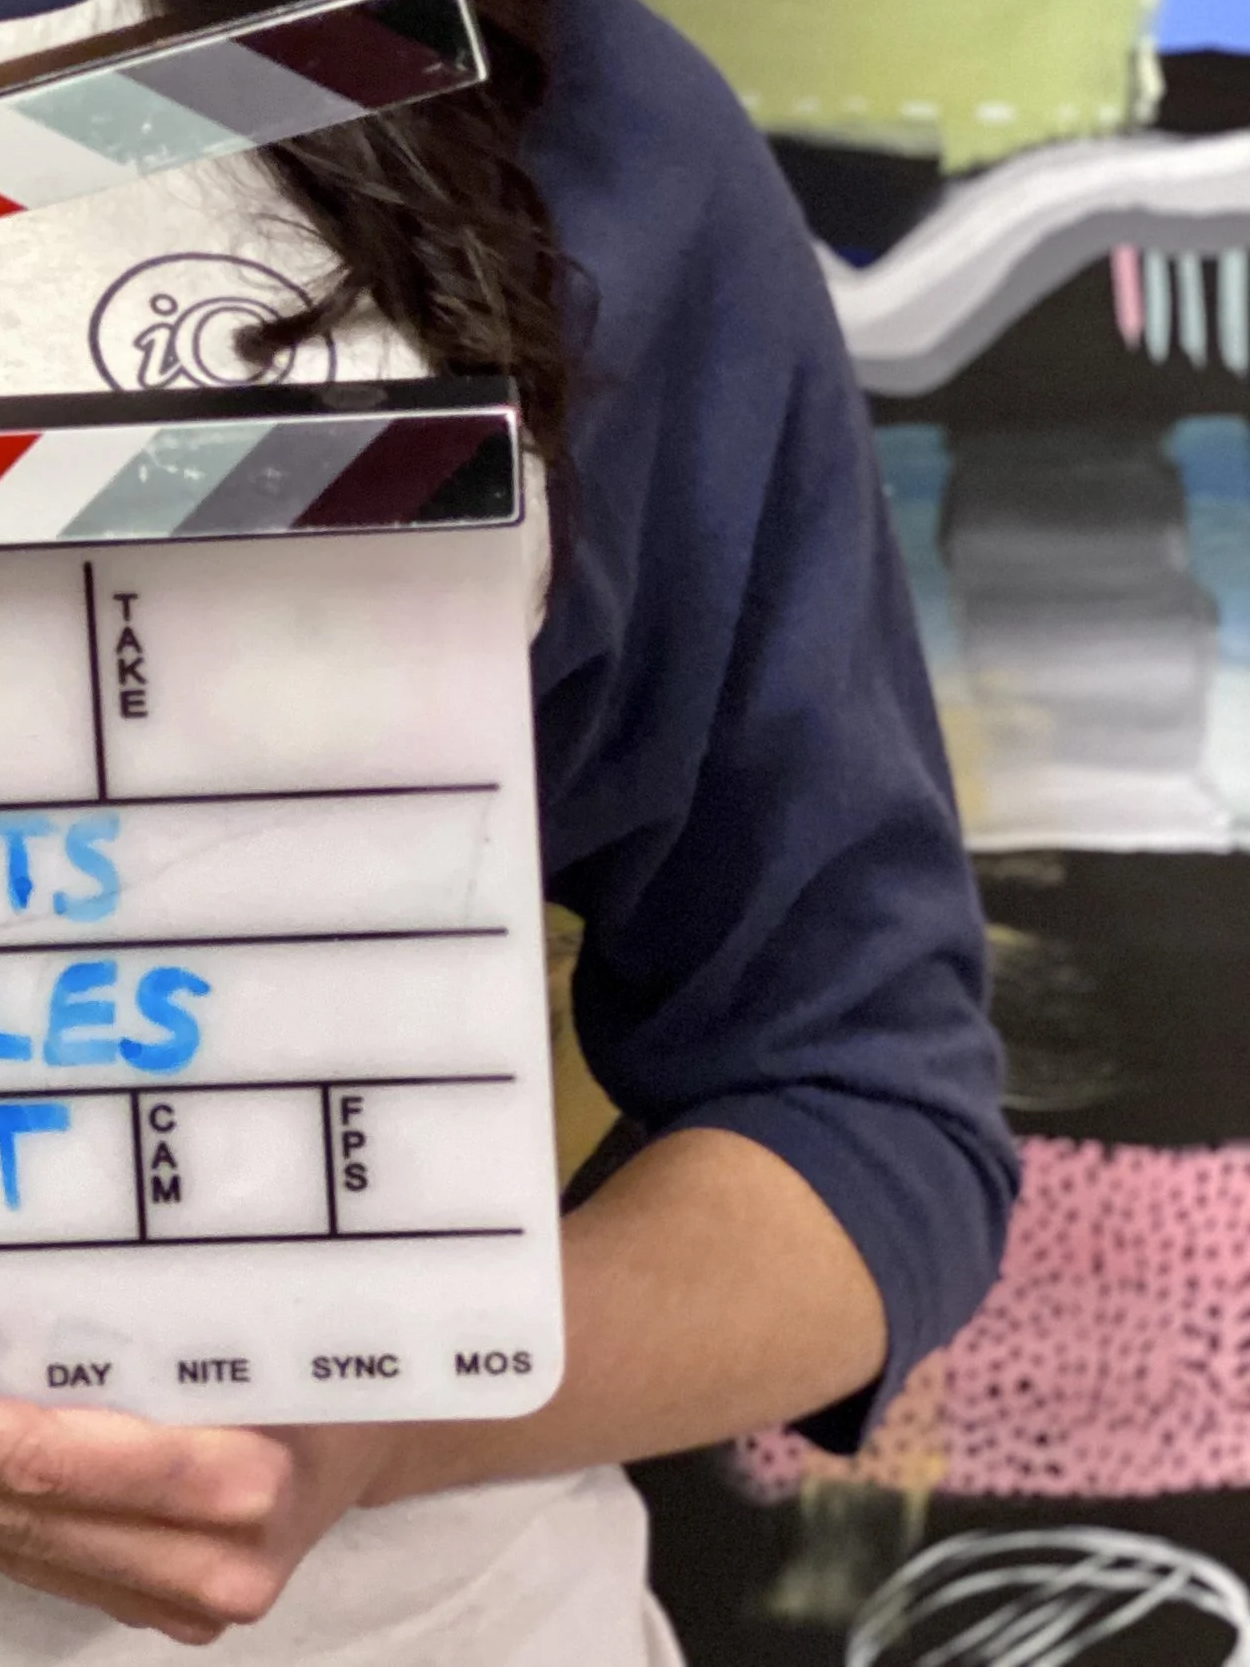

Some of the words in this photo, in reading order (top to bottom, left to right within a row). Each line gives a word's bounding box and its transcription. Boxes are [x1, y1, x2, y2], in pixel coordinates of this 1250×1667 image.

[112, 591, 148, 719] TAKE
[147, 1103, 182, 1204] CAM
[339, 1095, 368, 1192] FPS
[47, 1363, 112, 1388] DAY
[178, 1359, 249, 1383] NITE
[312, 1354, 400, 1380] SYNC
[455, 1352, 532, 1375] MOS
